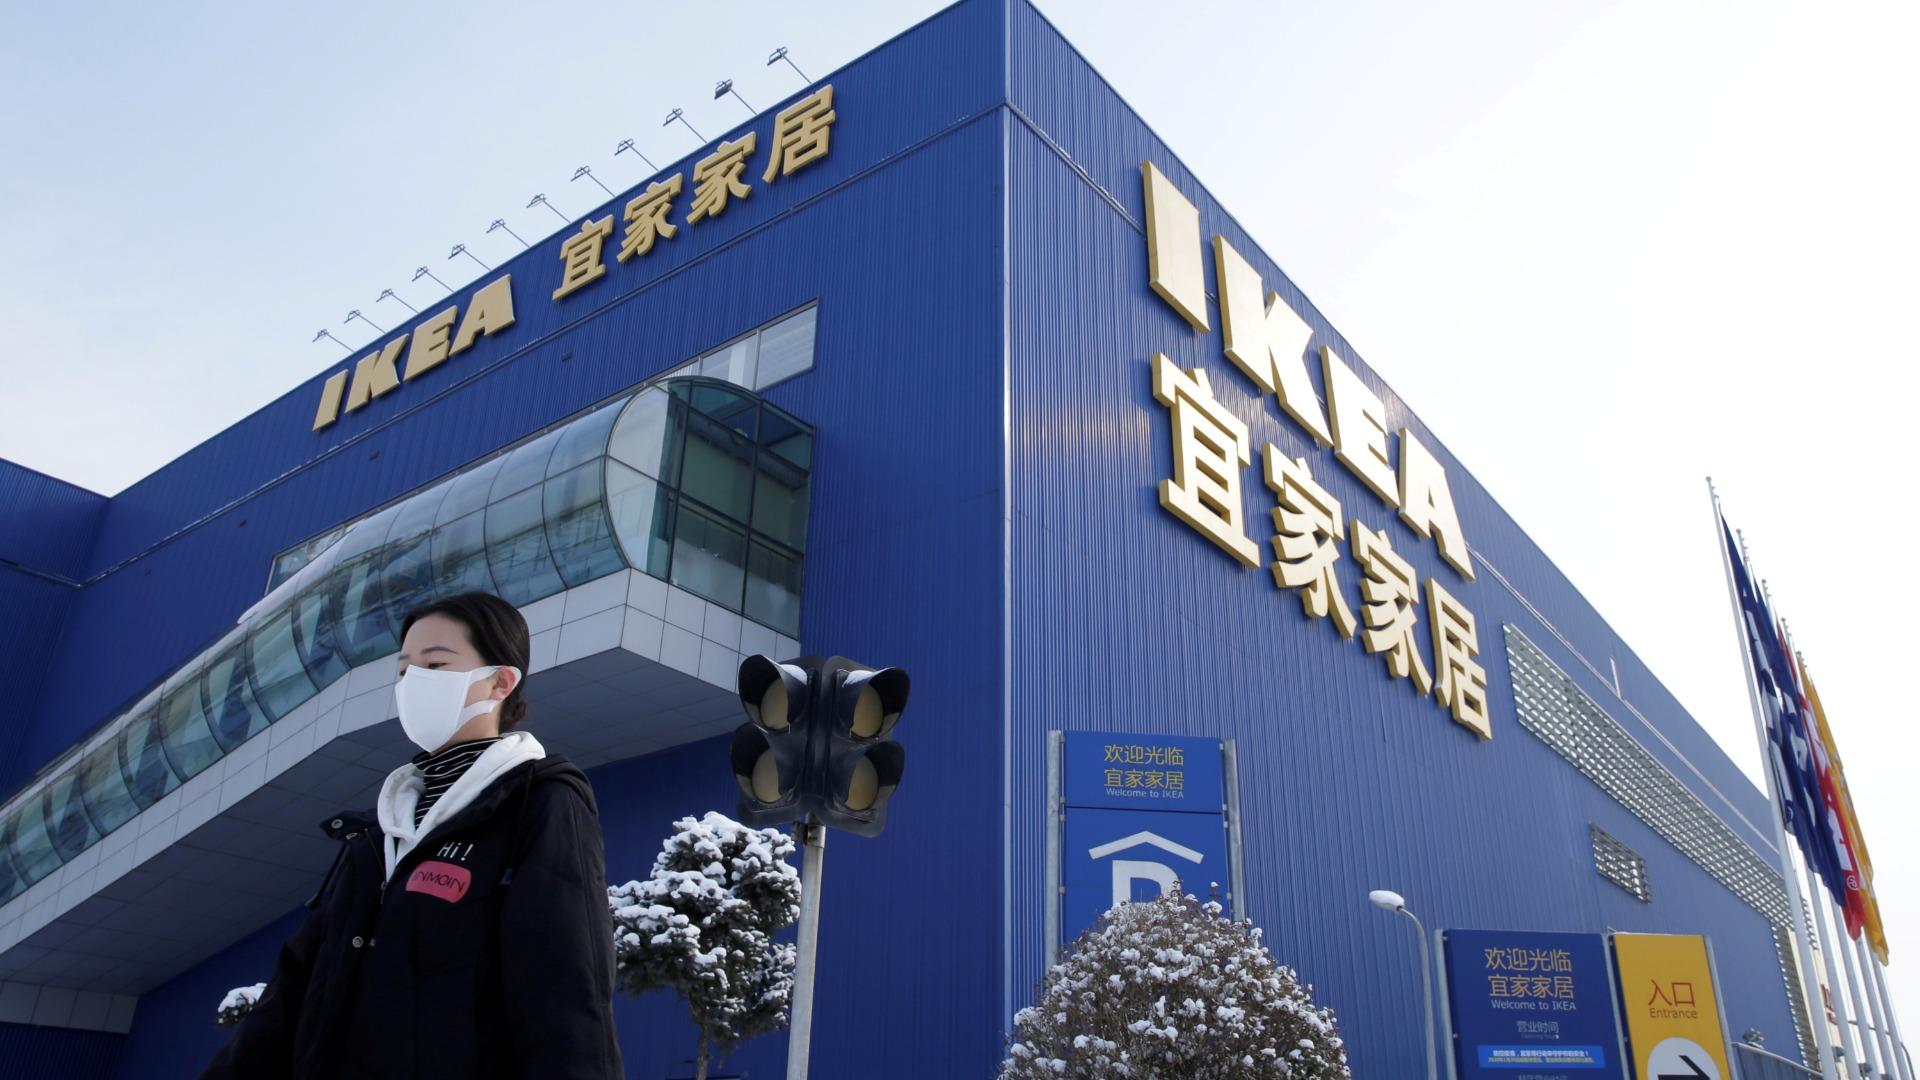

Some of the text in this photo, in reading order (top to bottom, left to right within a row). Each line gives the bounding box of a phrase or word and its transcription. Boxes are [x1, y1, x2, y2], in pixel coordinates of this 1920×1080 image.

[313, 84, 836, 432] IKEA 宜家家居
[1141, 160, 1476, 582] IKEA
[1152, 352, 1492, 740] 宜家家居
[1104, 744, 1184, 766] 欢迎光临
[1104, 768, 1184, 790] 宜家家居
[1106, 787, 1184, 799] Welcome to IKEA
[1484, 947, 1572, 972] 欢迎光临
[1488, 974, 1575, 999] 宜家家居
[1648, 979, 1695, 1007] 入口
[1491, 1000, 1576, 1011] Welcome to IKEA
[1650, 1007, 1698, 1019] Entrance
[1516, 1020, 1559, 1033] 营业时间
